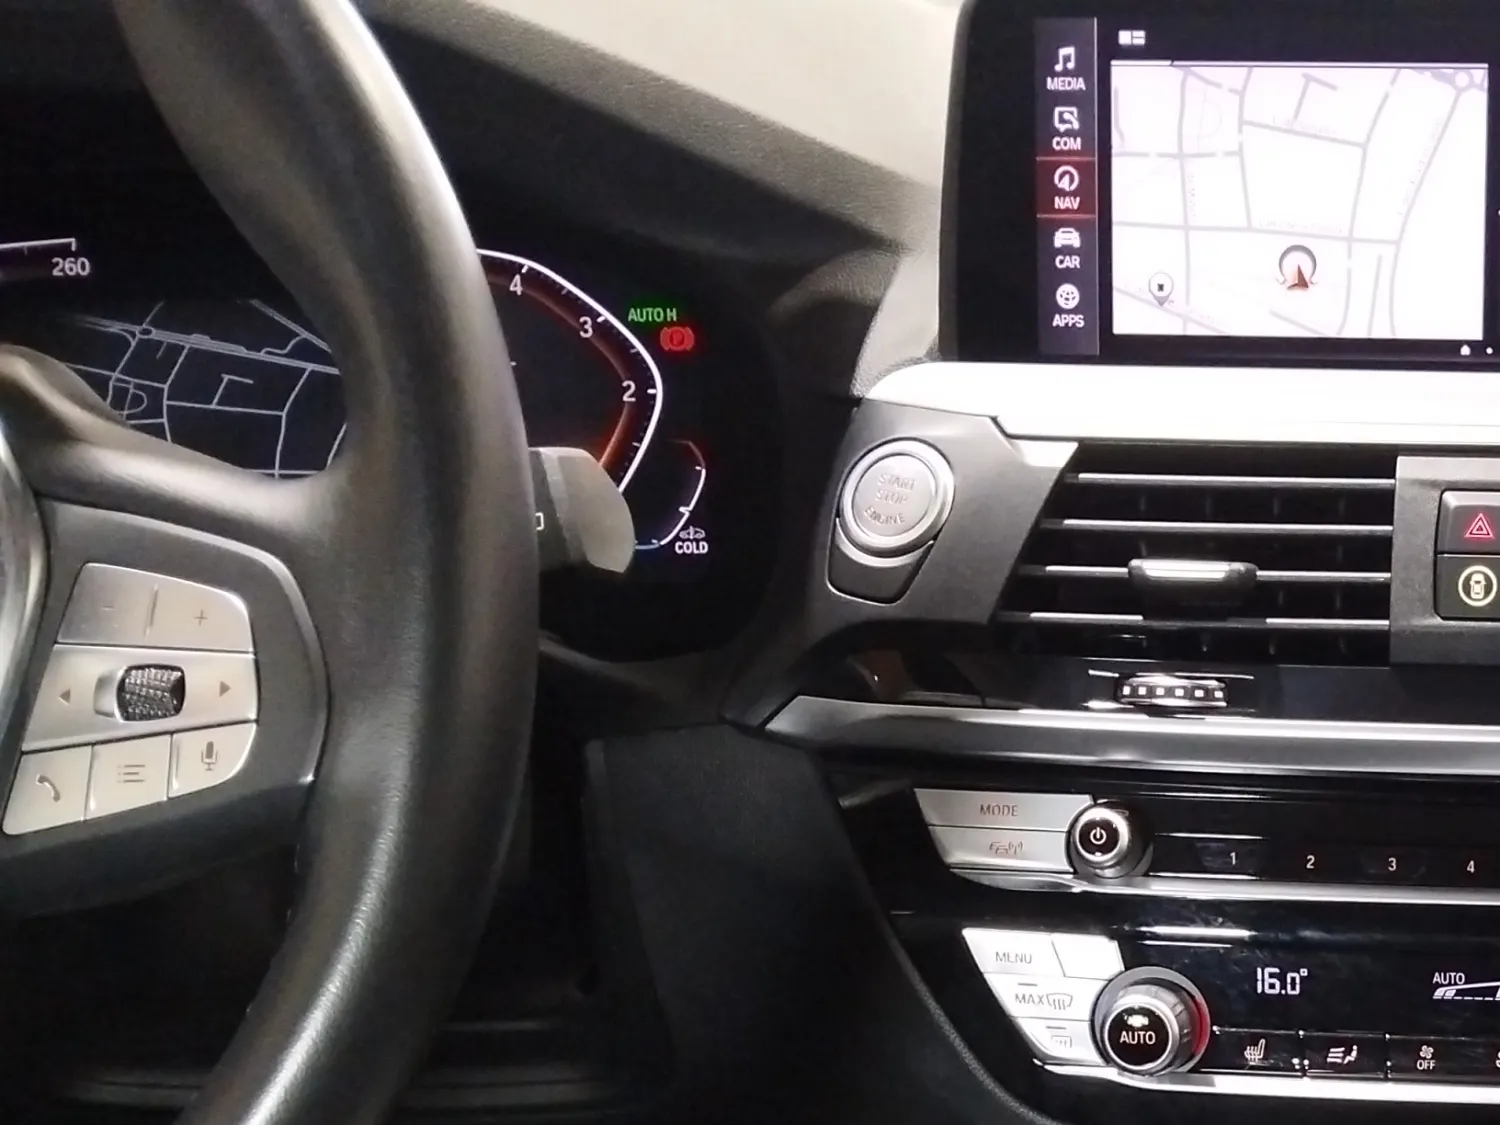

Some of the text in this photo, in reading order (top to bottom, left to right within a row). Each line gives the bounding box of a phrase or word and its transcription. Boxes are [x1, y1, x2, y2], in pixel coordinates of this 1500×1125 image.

[1046, 77, 1086, 91] MEDIA
[1052, 137, 1082, 151] COM
[1054, 196, 1080, 210] NAV
[51, 257, 91, 277] 260
[1055, 255, 1081, 269] CAR
[509, 274, 523, 296] 4
[627, 307, 677, 322] AUTO H
[1052, 314, 1085, 328] APPS
[579, 316, 593, 338] 3
[622, 380, 637, 402] 2
[878, 473, 917, 492] START
[875, 487, 909, 505] STOP
[864, 505, 905, 525] ENGINE
[674, 541, 709, 554] COLD
[980, 804, 1019, 817] MODE
[1229, 852, 1237, 865] 1
[1305, 855, 1316, 870] 2
[1387, 857, 1398, 872] 3
[1466, 860, 1476, 874] 4
[995, 951, 1032, 965] MENU
[1432, 972, 1465, 985] AUTO
[1014, 993, 1045, 1006] MAX
[1119, 1030, 1156, 1045] AUTO
[1416, 1060, 1436, 1071] OFF
